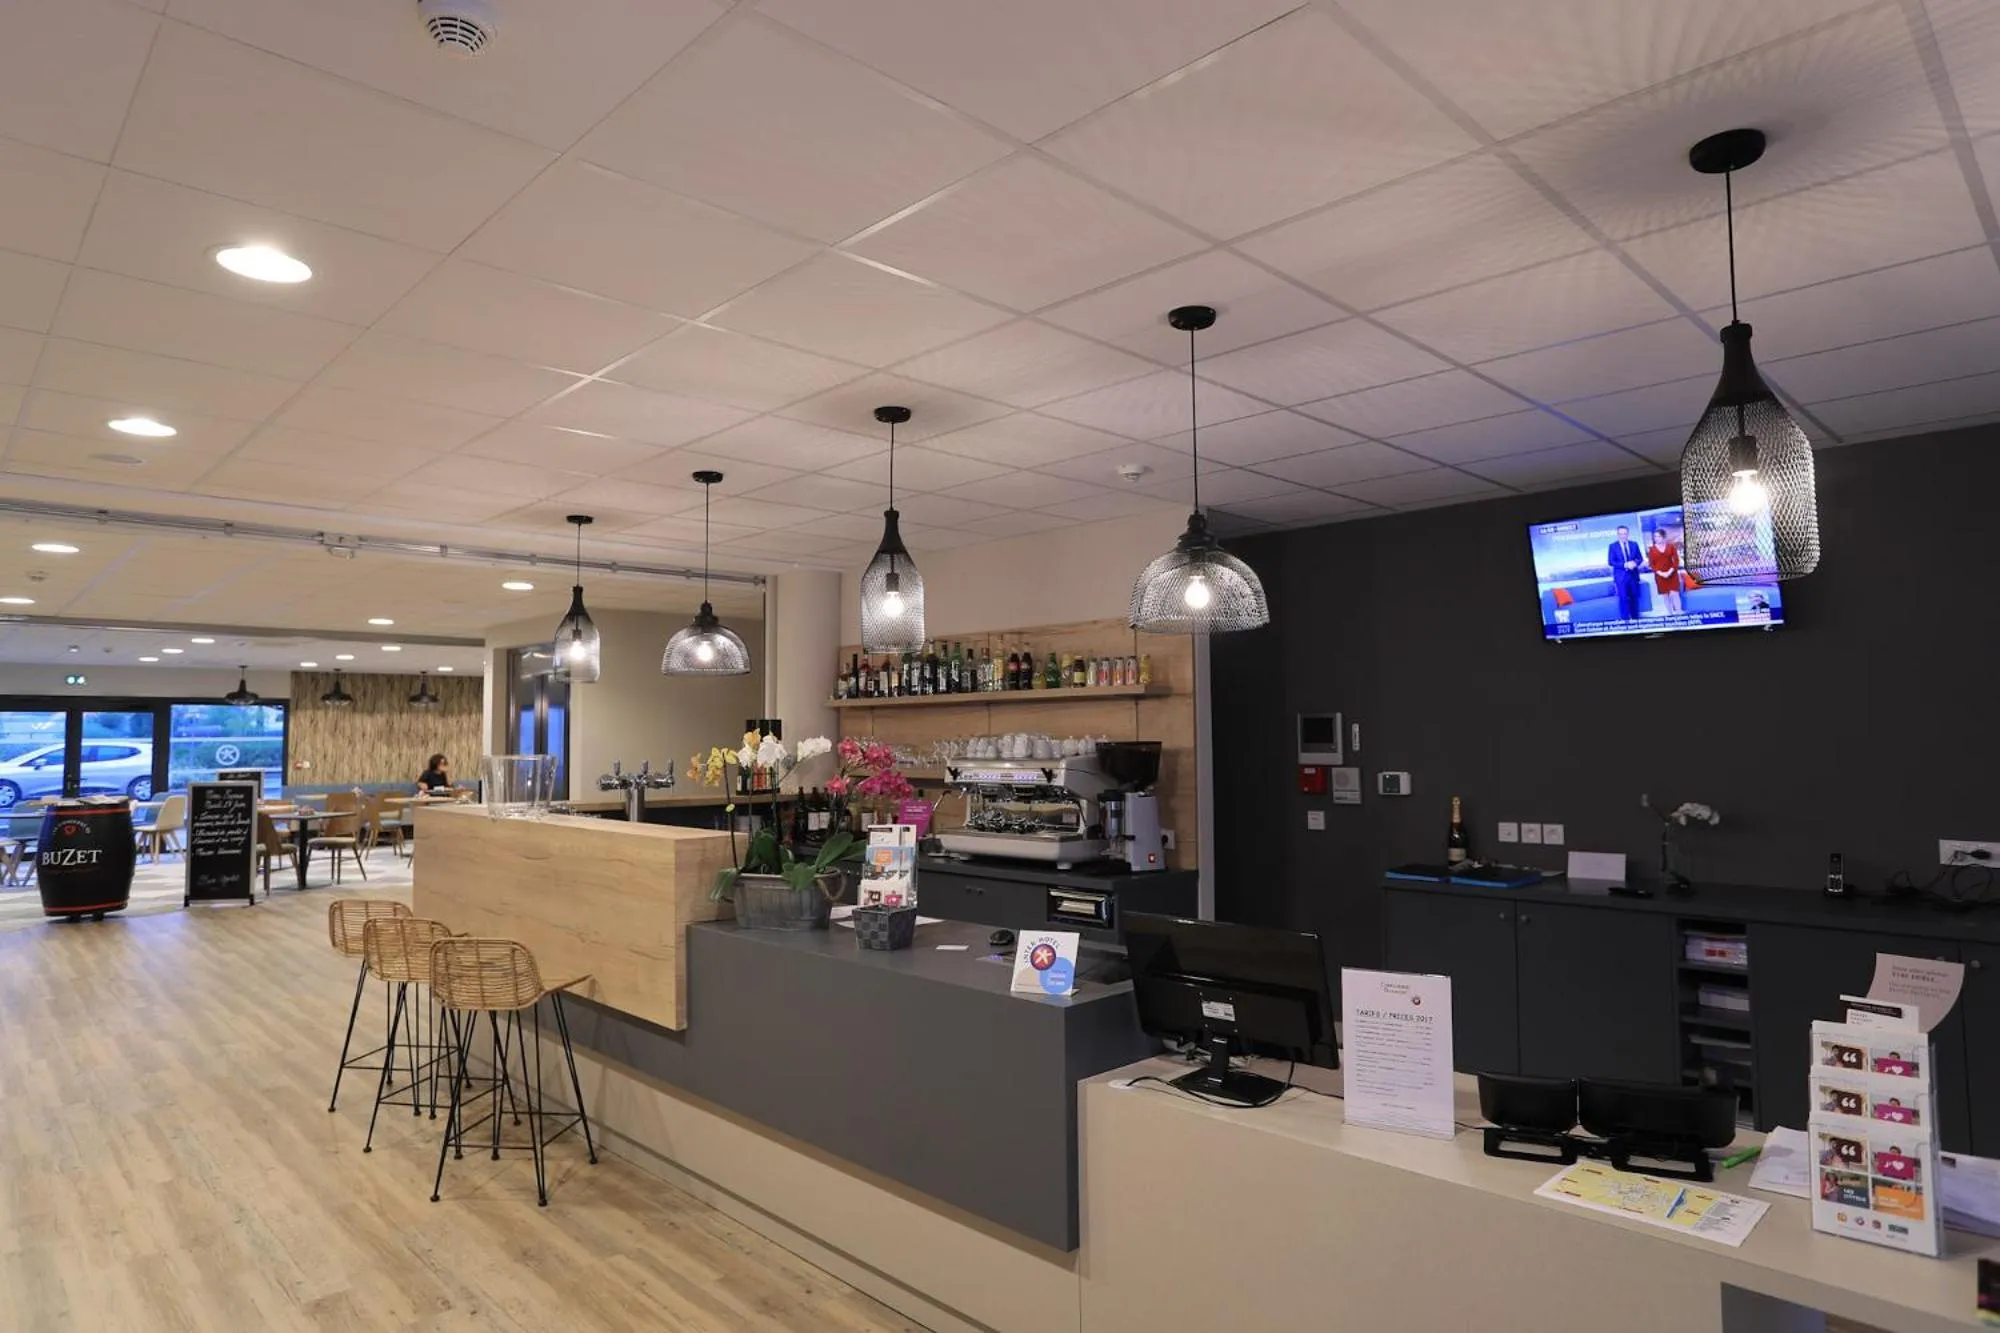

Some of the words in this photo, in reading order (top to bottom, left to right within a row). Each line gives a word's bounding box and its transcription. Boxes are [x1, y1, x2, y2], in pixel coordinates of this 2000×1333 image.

[41, 848, 102, 866] BUZET
[1023, 940, 1036, 964] INTER
[1038, 936, 1060, 949] HOTEL
[1356, 1008, 1380, 1018] TARIFS
[1389, 1012, 1414, 1021] PRICES
[1415, 1014, 1433, 1024] 2017
